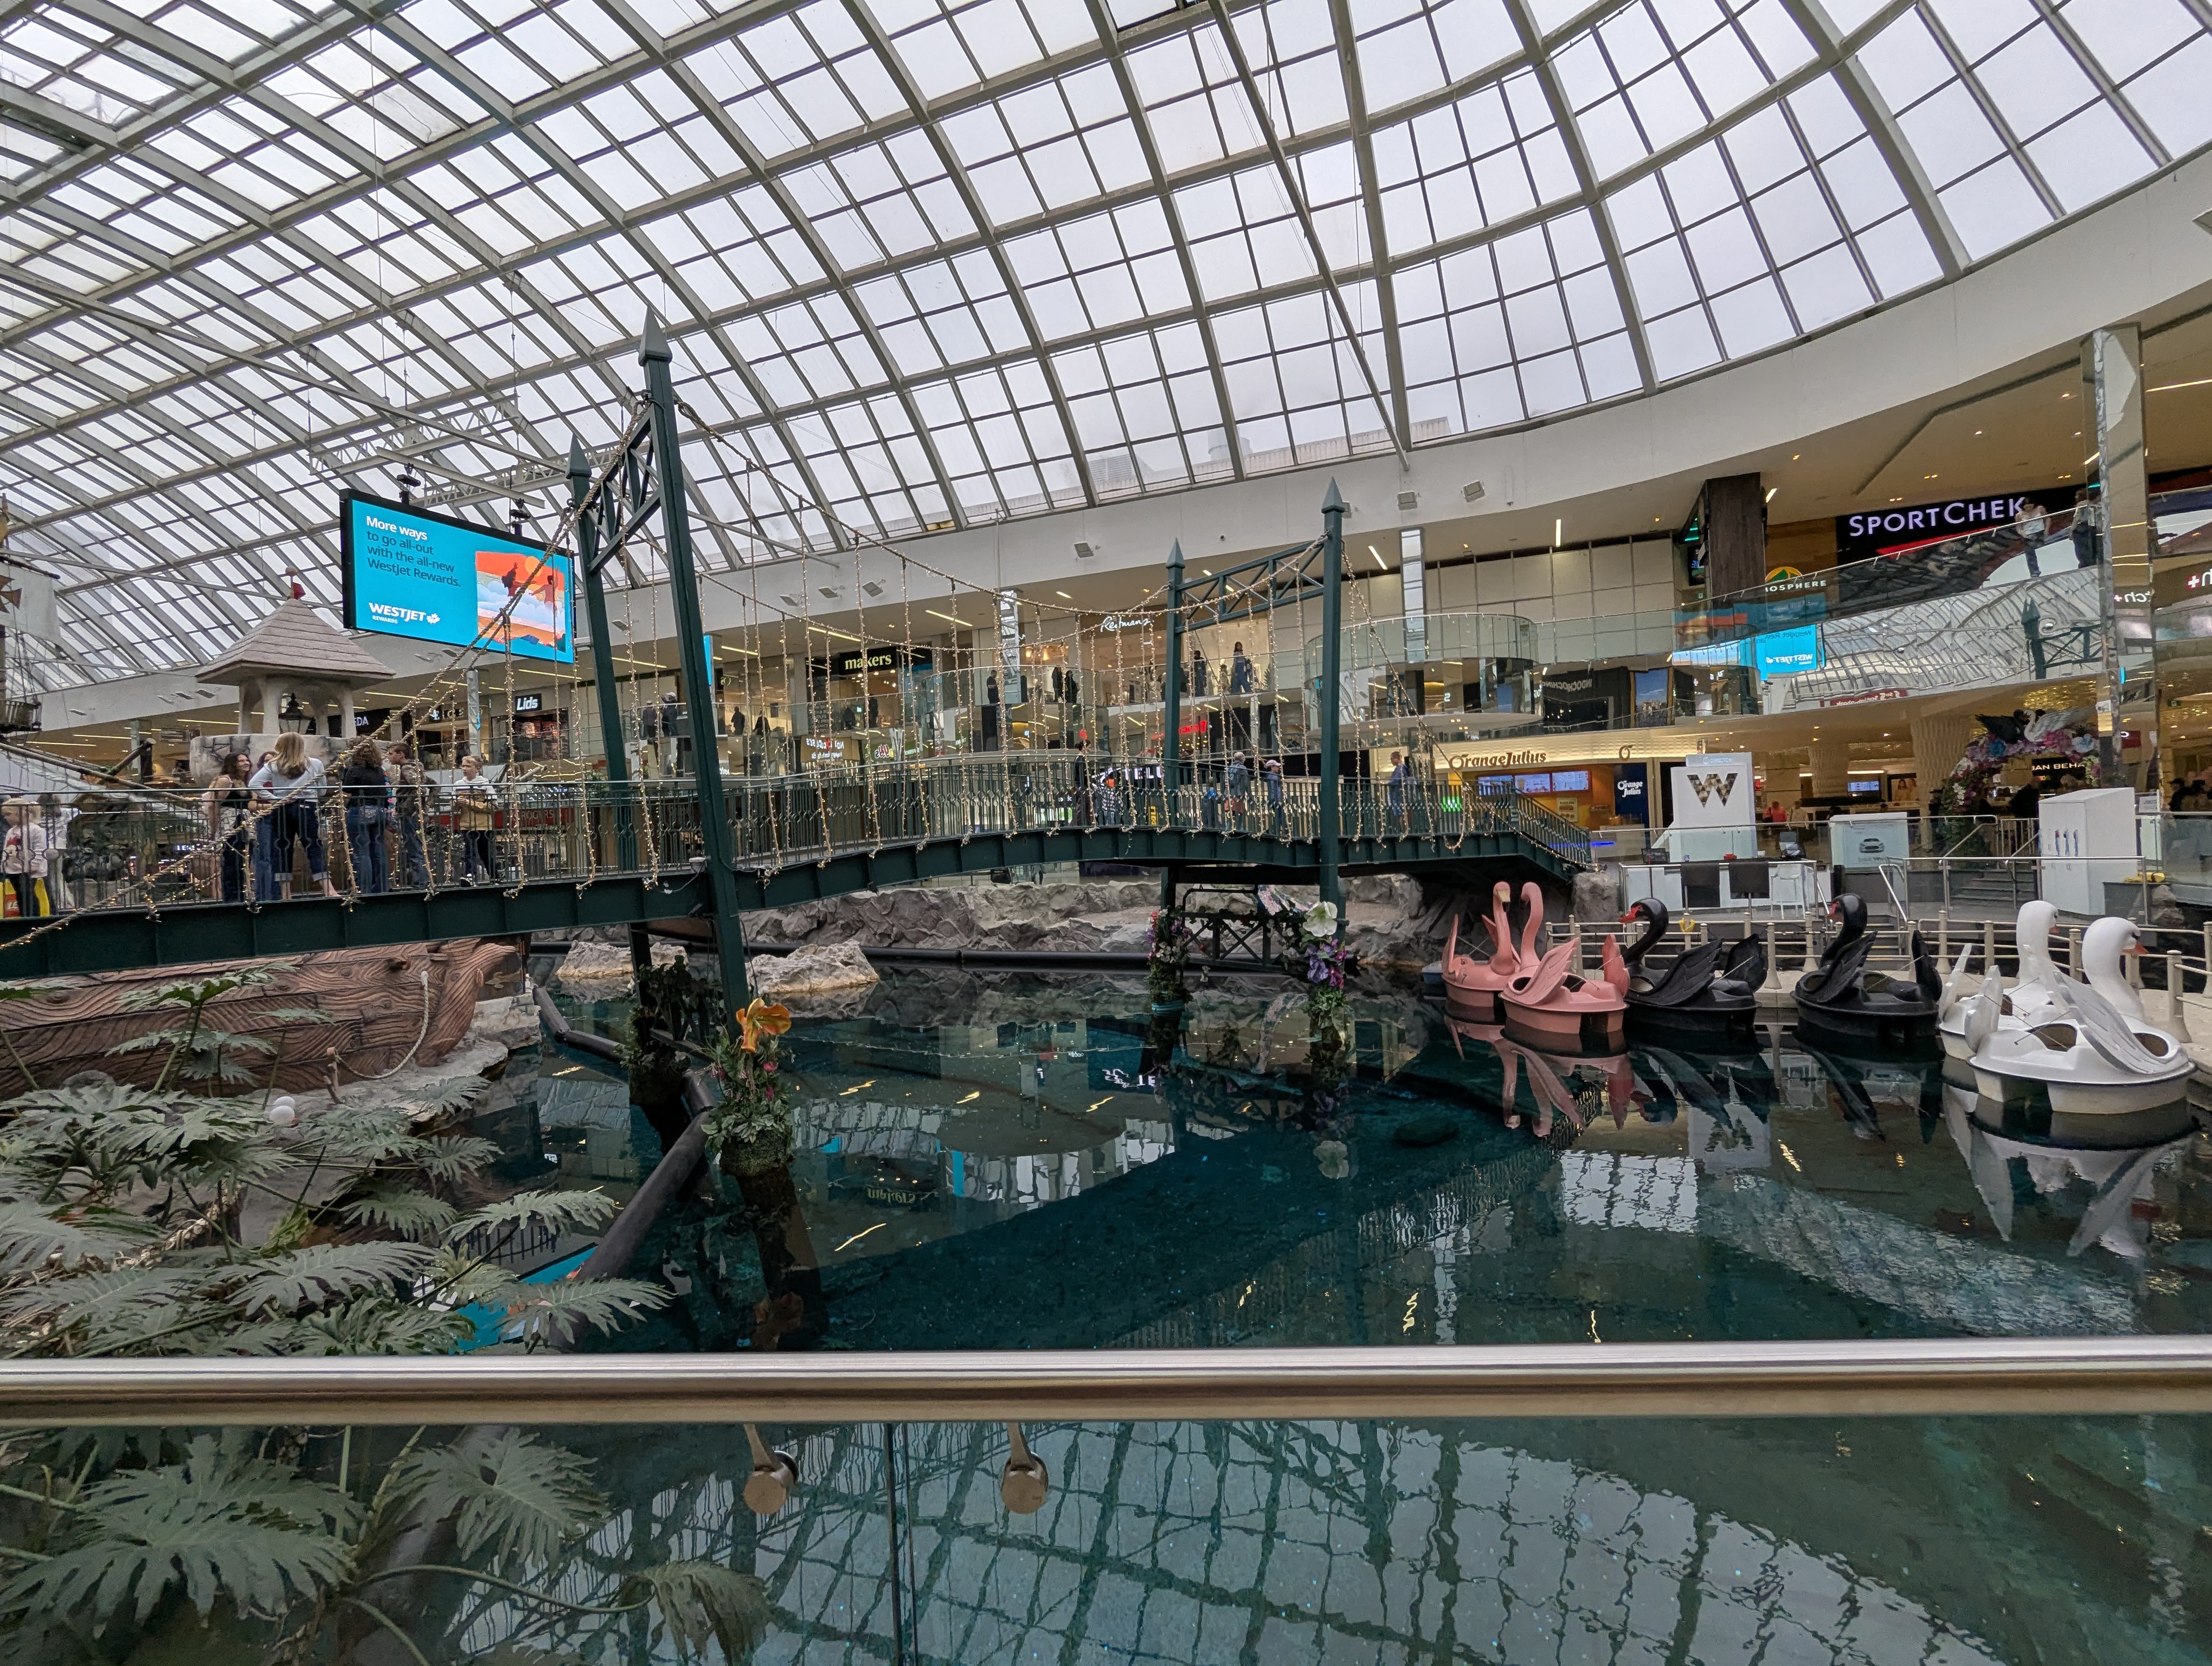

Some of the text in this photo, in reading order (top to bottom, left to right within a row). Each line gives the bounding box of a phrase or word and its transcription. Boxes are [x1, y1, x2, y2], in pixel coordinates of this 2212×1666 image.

[366, 515, 428, 541] More ways
[366, 530, 434, 555] to go all-out
[367, 546, 454, 573] with the all-new
[367, 557, 461, 587] WestJet Rewards.
[368, 602, 427, 622] WESTJET
[372, 615, 398, 624] REWARDS
[845, 655, 892, 670] makers
[516, 696, 538, 710] Lids
[1617, 780, 1643, 790] Orange
